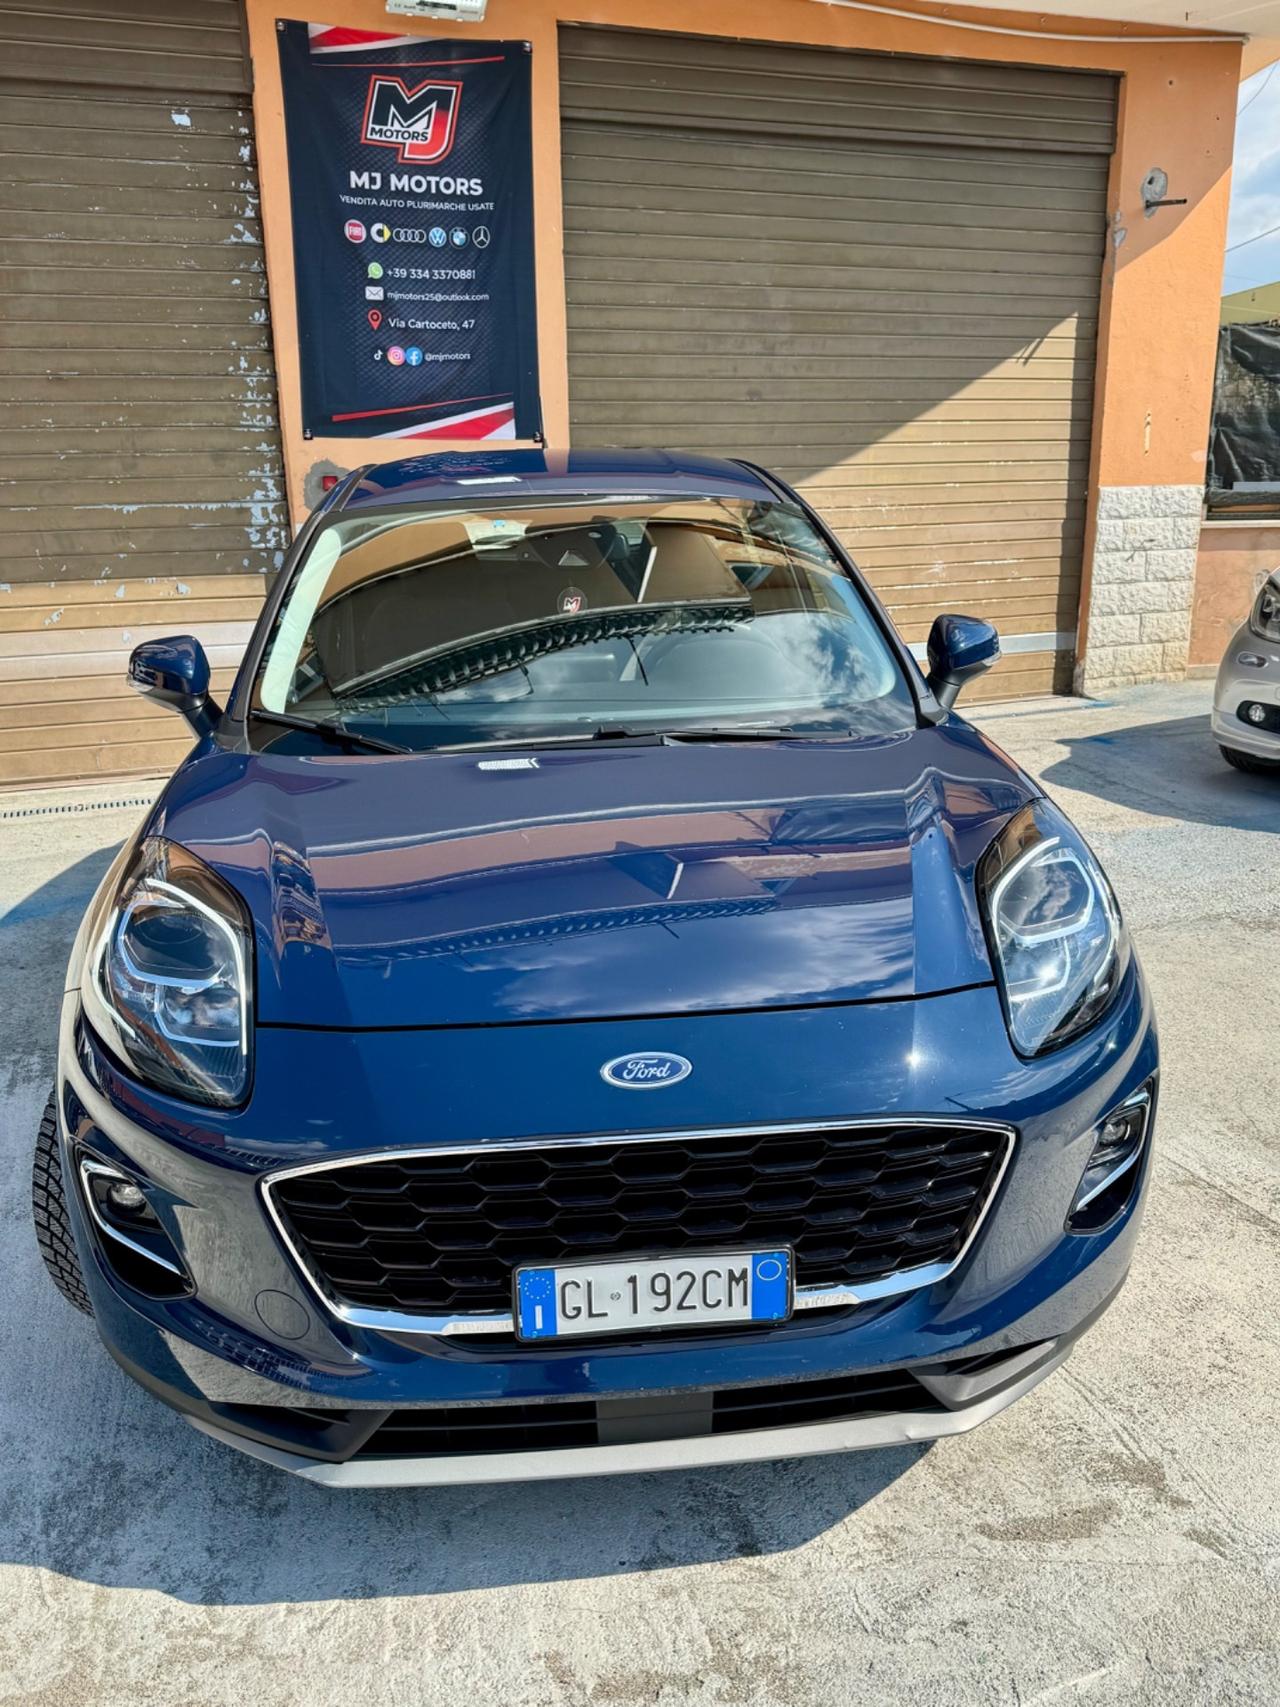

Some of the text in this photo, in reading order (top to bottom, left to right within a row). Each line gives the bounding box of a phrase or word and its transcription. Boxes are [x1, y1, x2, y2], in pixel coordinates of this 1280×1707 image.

[369, 126, 429, 142] MOTORS
[349, 170, 484, 196] MJ MOTORS
[339, 194, 495, 211] VENDITA AUTO PLURIMARCHE USATE
[386, 267, 476, 280] +39 334 3370881
[386, 291, 490, 303] mjmotors25@outlook.com
[388, 318, 475, 331] Via Cartoceto, 47
[424, 352, 471, 362] @mjmotors
[622, 1058, 671, 1082] Ford
[559, 1265, 749, 1320] GL 192CM
